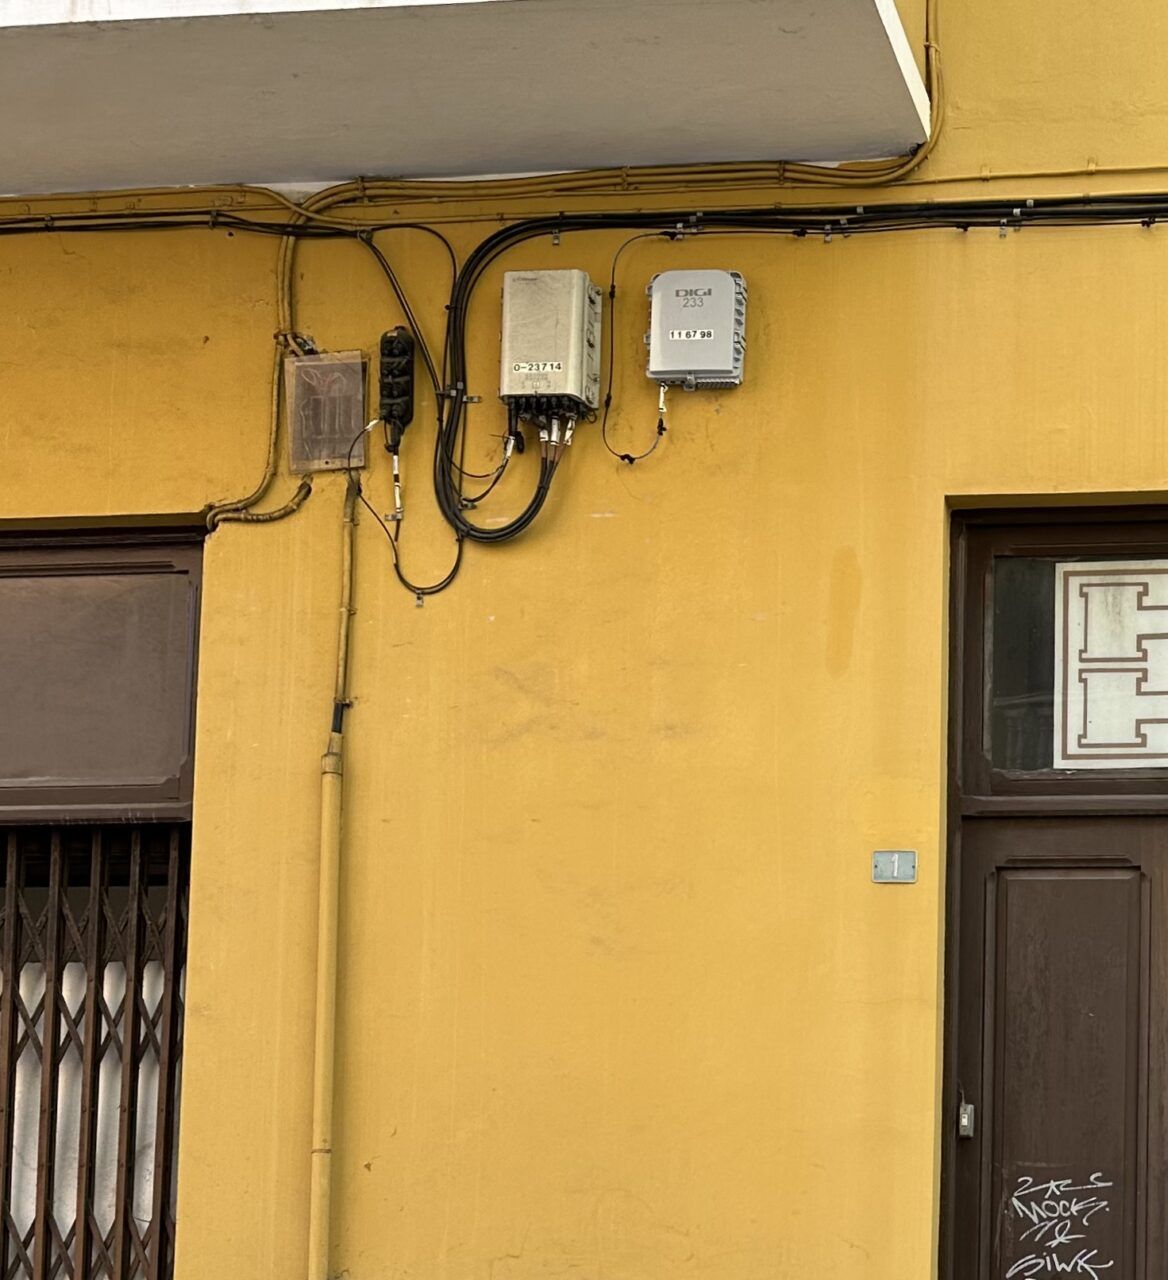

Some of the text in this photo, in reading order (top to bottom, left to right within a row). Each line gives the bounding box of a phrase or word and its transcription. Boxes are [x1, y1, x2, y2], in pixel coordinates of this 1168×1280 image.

[675, 288, 712, 297] DIGI
[682, 297, 704, 308] 233
[891, 853, 899, 877] 1
